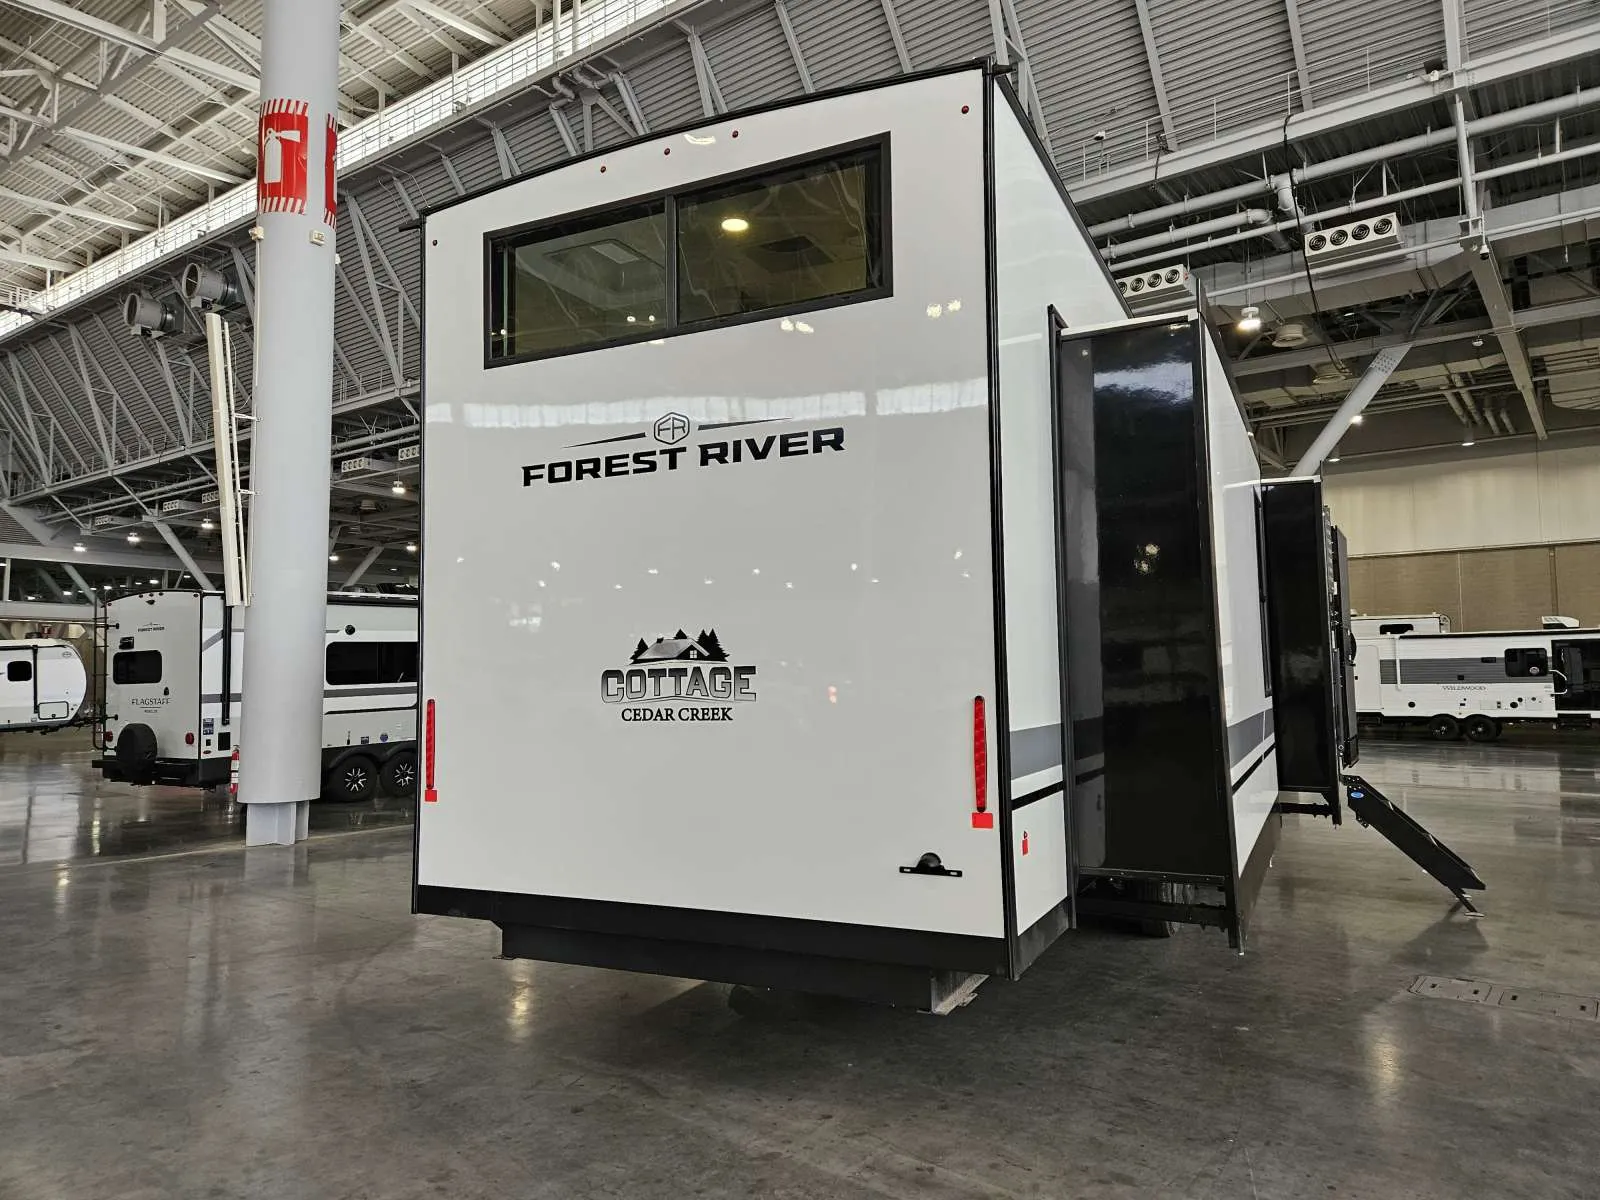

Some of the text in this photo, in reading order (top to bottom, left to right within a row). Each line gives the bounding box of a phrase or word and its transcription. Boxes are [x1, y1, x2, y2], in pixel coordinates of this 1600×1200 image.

[521, 427, 846, 487] FOREST RIVER
[601, 666, 757, 703] COTTAGE
[621, 707, 733, 722] CEDAR CREEK
